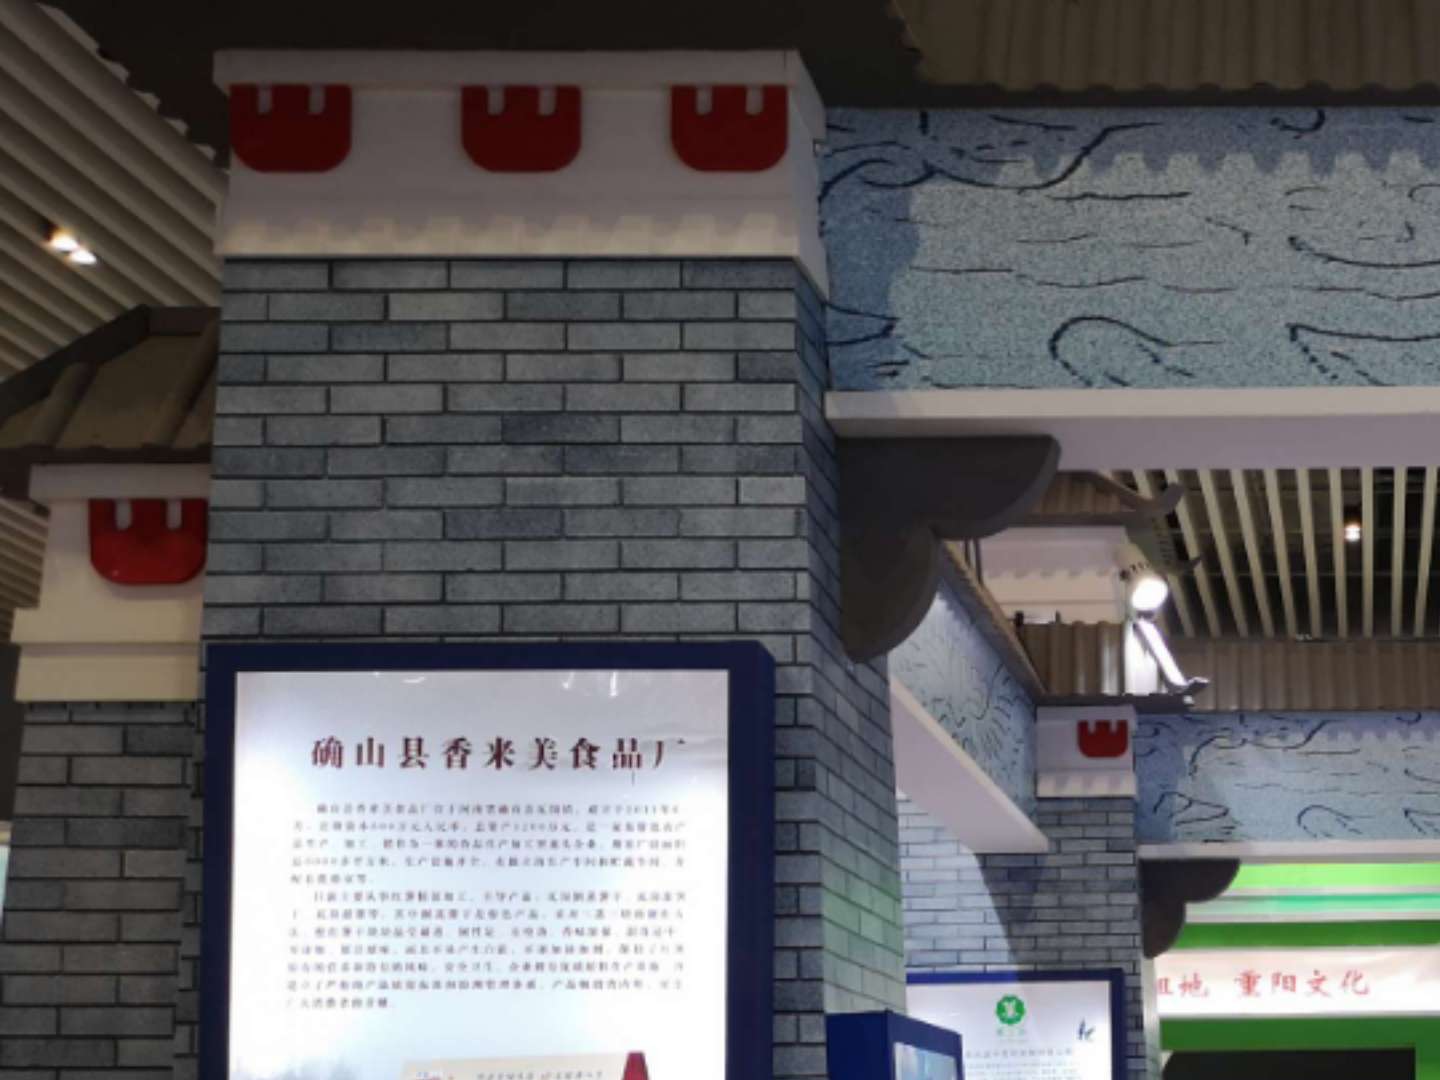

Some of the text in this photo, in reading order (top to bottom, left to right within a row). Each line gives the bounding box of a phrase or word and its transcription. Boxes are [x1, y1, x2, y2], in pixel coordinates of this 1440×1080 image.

[311, 735, 686, 771] 确山县香来美食品厂
[1233, 968, 1371, 998] 重阳文化
